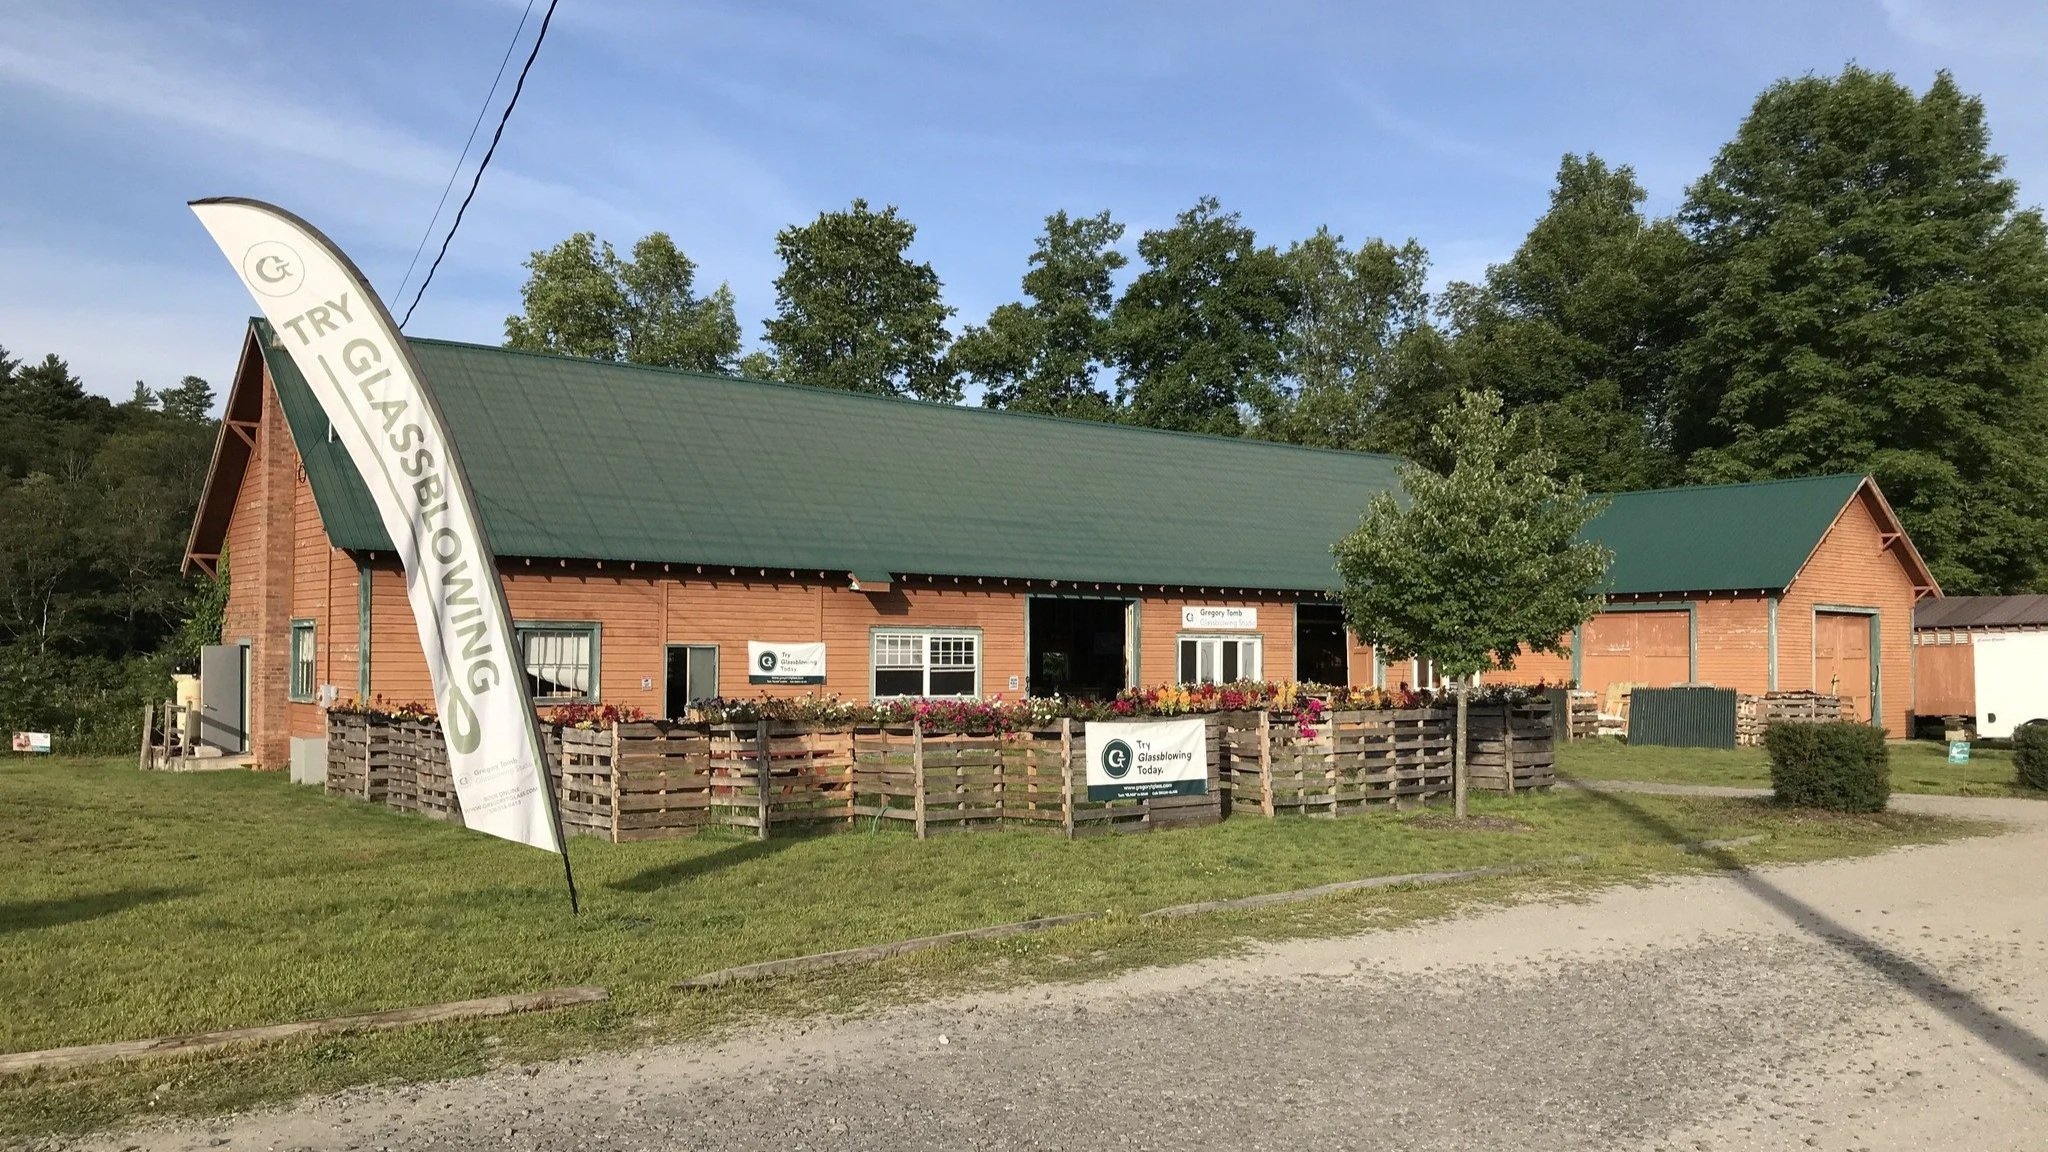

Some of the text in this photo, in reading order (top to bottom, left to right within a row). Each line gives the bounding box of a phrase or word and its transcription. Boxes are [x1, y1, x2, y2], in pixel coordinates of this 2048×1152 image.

[282, 292, 354, 346] TRY
[342, 337, 501, 696] GLASSBLOWING
[1200, 608, 1243, 618] Gregory Tomb
[1136, 740, 1151, 751] Try
[1137, 750, 1192, 762] Glassblowing
[1137, 765, 1164, 775] Today.
